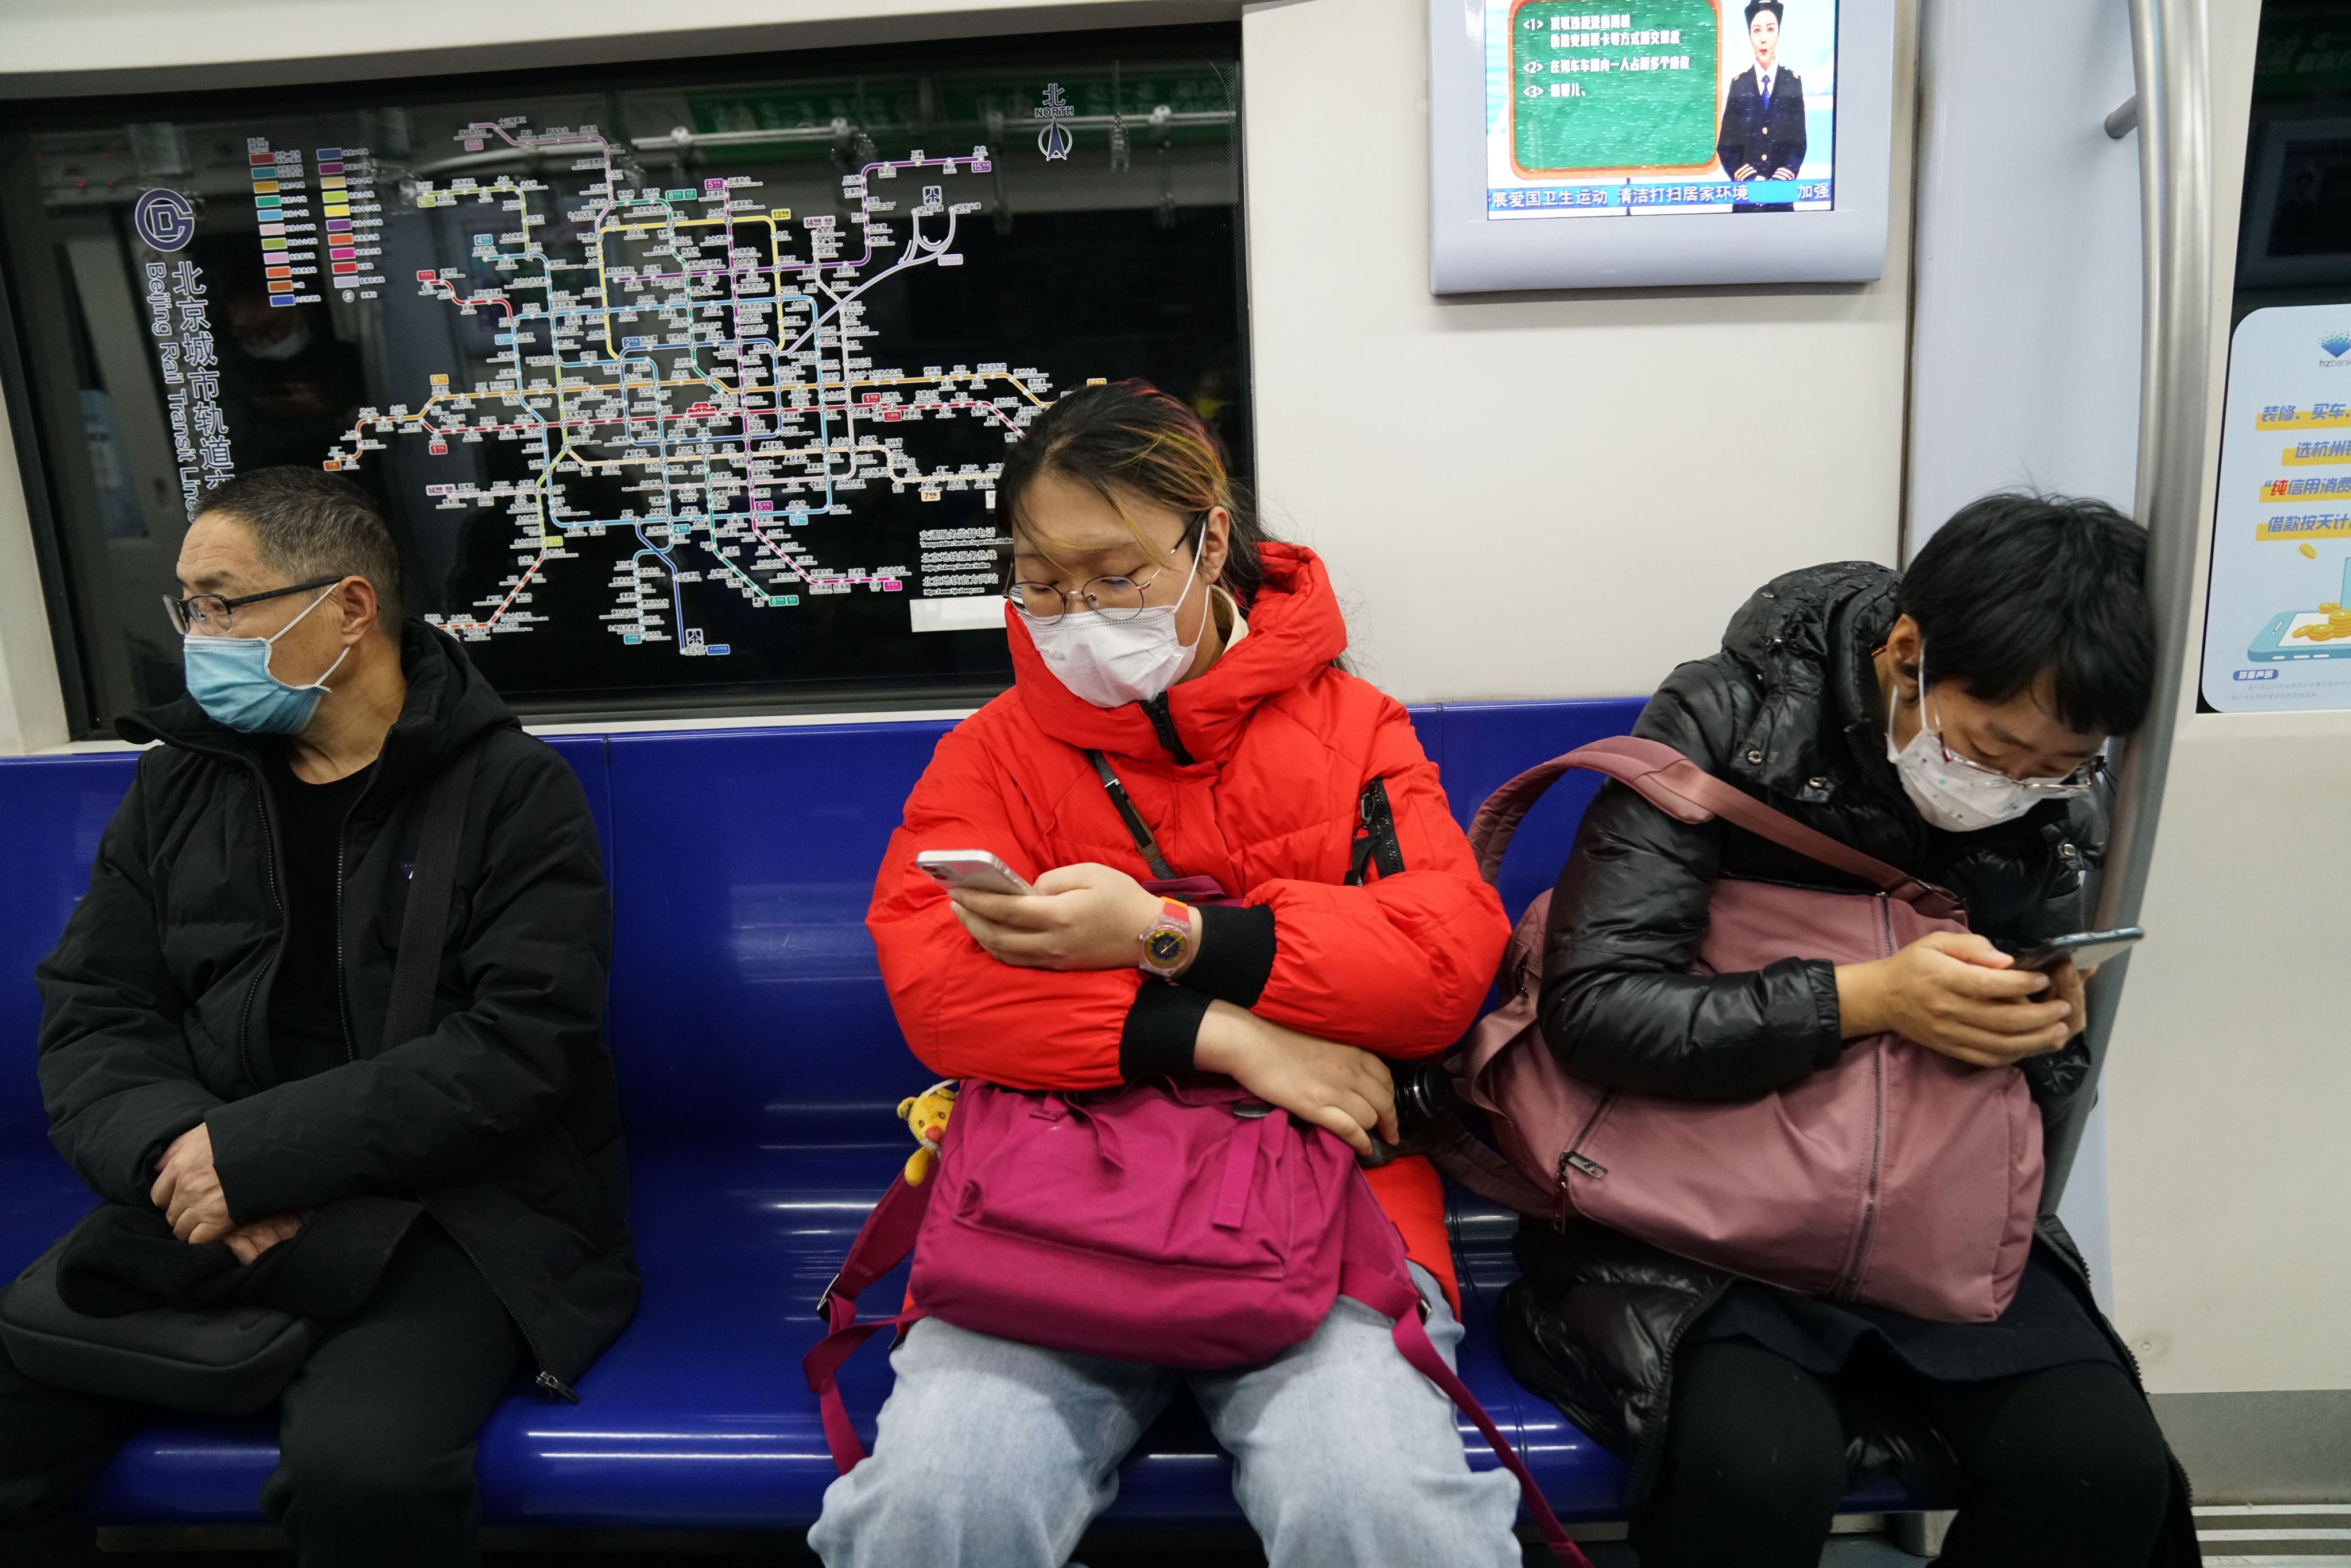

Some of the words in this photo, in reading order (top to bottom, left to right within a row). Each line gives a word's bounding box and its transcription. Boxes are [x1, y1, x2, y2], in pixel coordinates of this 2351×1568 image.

[1042, 83, 1066, 106] 北
[1034, 106, 1074, 118] NORTH
[1488, 189, 1607, 208] 展爱国卫生运动
[1617, 184, 1748, 204] 清洁打扫居家环境
[1798, 183, 1829, 199] 加强
[146, 262, 172, 336] Beijing
[160, 342, 184, 384] Rail
[167, 389, 196, 462] Transit
[2267, 514, 2351, 533] 借款按天计
[920, 527, 996, 541] 交通服务监督电话
[920, 540, 954, 548] Transportation
[971, 539, 998, 547] Supervision
[921, 550, 998, 563] 北京地铁服务热线
[922, 573, 998, 586] 北京地铁官方网站
[2239, 670, 2273, 680] 郑重声明
